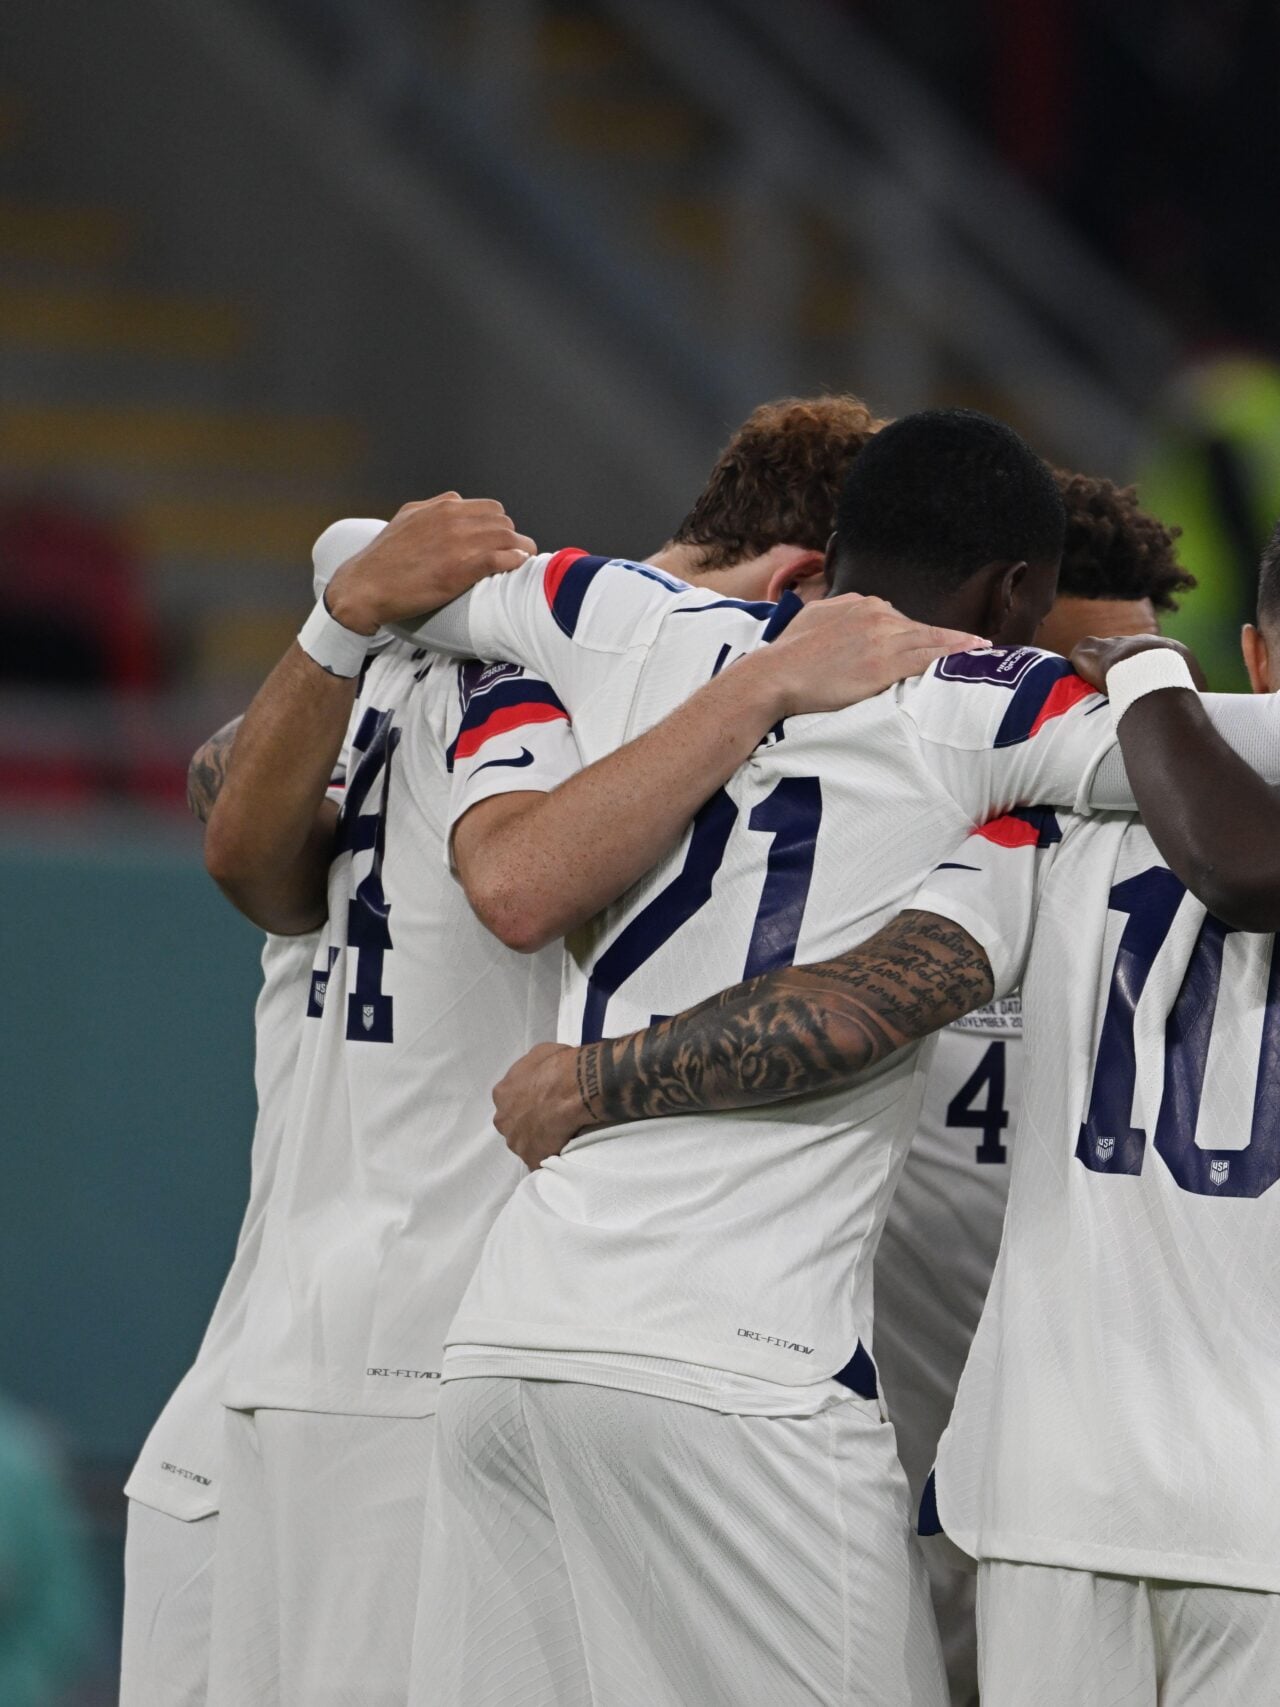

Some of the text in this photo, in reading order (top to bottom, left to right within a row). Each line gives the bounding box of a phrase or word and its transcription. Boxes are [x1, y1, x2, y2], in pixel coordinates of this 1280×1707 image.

[581, 776, 823, 1046] 21
[945, 1041, 1009, 1163] 4
[1098, 1138, 1115, 1149] USA
[1211, 1161, 1229, 1173] USA
